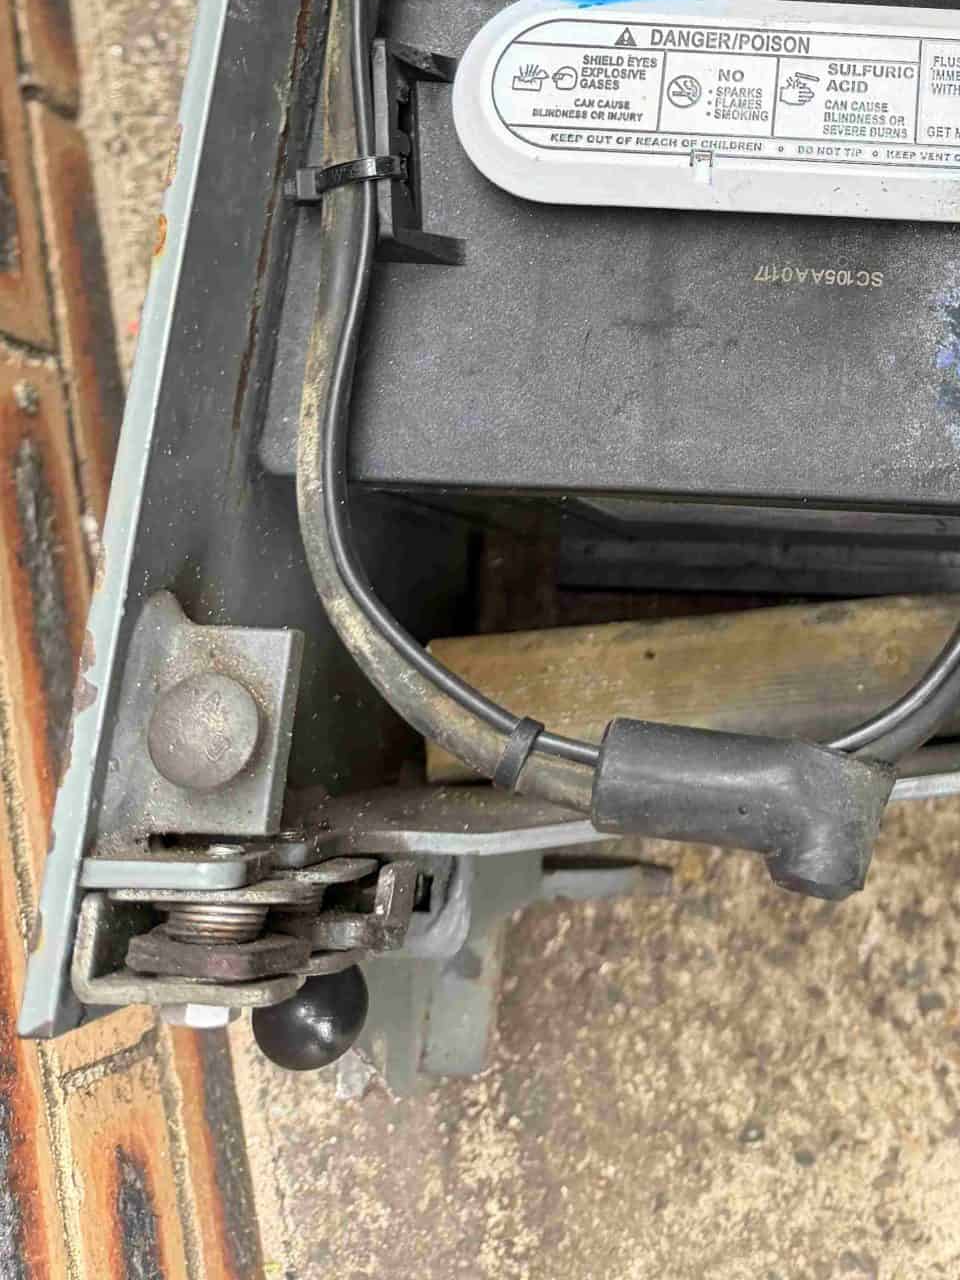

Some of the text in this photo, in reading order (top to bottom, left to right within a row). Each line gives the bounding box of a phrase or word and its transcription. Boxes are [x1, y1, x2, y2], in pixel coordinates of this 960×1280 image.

[650, 28, 811, 54] DANGER/POISON
[582, 54, 658, 68] SHIELD EYES
[581, 66, 646, 80] EXPLOSIVE
[718, 68, 745, 82] NO
[827, 62, 915, 80] SULFURIC
[580, 78, 621, 90] GASES
[826, 79, 869, 94] ACID
[930, 81, 960, 96] WITH
[716, 86, 763, 98] SPARKS
[574, 98, 631, 110] CAN CAUSE
[715, 98, 763, 110] FLAMES
[824, 99, 889, 113] CAN CAUSE
[532, 108, 644, 122] BLINDNESS OR INJURY
[713, 109, 769, 121] SMOKING
[823, 111, 905, 127] BLINDNESS OR
[822, 123, 908, 139] SEVERE BURNS
[926, 125, 952, 139] GET
[549, 132, 583, 144] KEEP
[586, 134, 613, 145] OUT
[615, 135, 633, 145] OF
[635, 136, 678, 148] REACH
[680, 138, 698, 149] OF
[700, 138, 763, 153] CHILDREN
[797, 144, 814, 155] DO
[816, 145, 842, 157] NOT
[843, 147, 863, 158] TIP
[886, 148, 917, 160] KEEP
[919, 150, 951, 162] VENT
[751, 265, 885, 288] SC105AA0117
